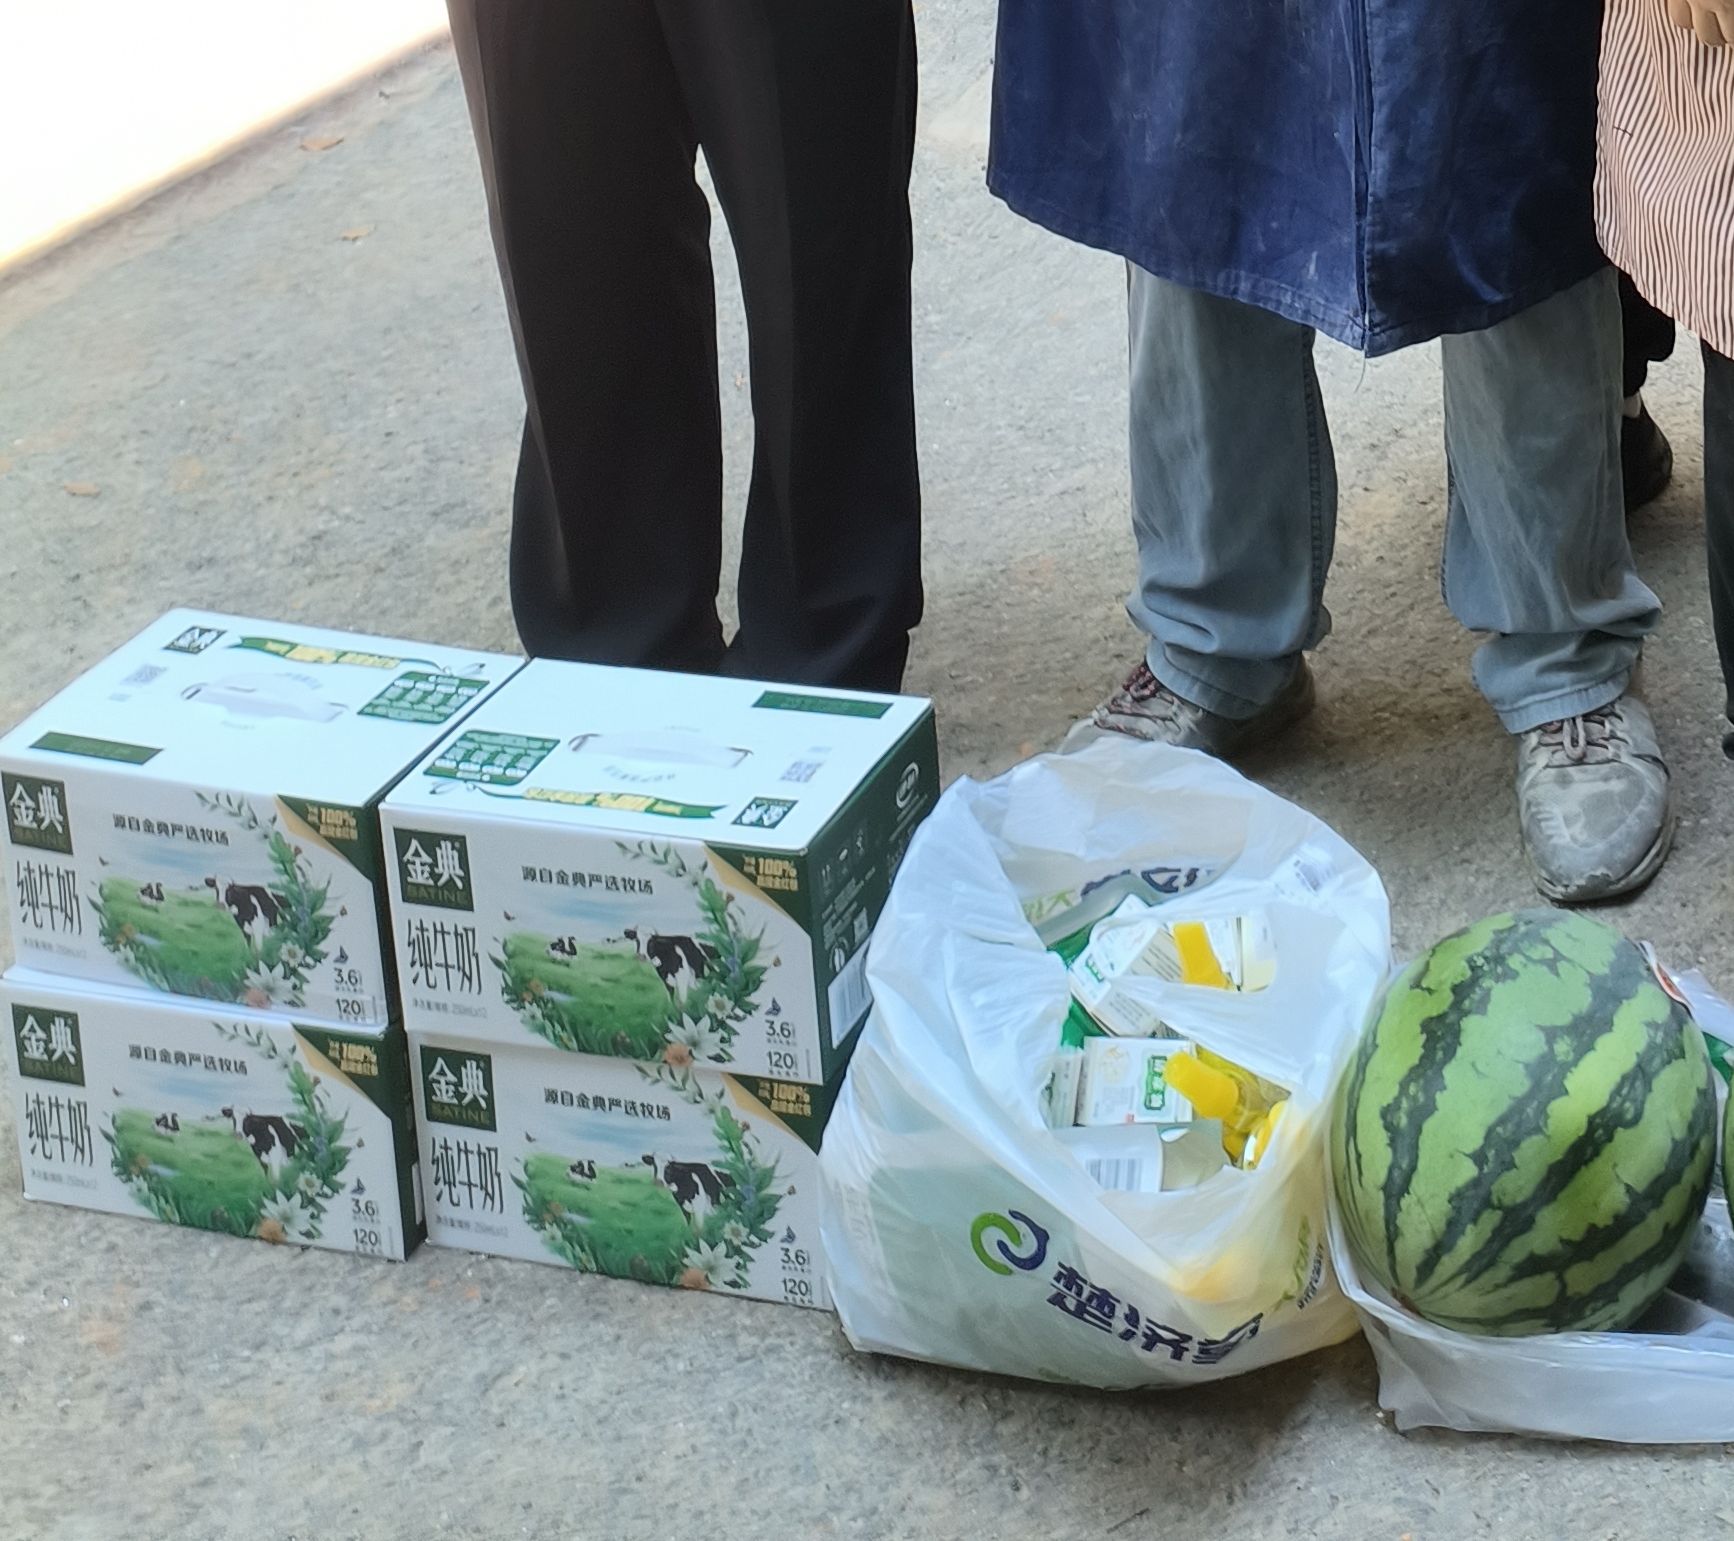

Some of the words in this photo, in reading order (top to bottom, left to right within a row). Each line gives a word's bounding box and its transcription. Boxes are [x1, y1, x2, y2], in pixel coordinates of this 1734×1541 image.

[9, 781, 64, 834] 金典
[112, 813, 230, 847] 源自金典严选牧场
[402, 837, 464, 890] 金典
[521, 865, 654, 894] 源自金典严选牧场
[16, 860, 82, 935] 纯牛奶
[407, 918, 482, 995] 纯牛奶
[336, 998, 361, 1015] 120
[19, 1013, 77, 1066] 金典
[129, 1044, 248, 1075] 源自金典严选牧场
[768, 1051, 794, 1069] 120
[428, 1057, 488, 1109] 金典
[544, 1087, 671, 1121] 源自金典严选牧场
[25, 1092, 93, 1166] 纯牛奶
[431, 1137, 504, 1214] 纯牛奶
[354, 1228, 378, 1246] 120
[783, 1278, 808, 1296] 120
